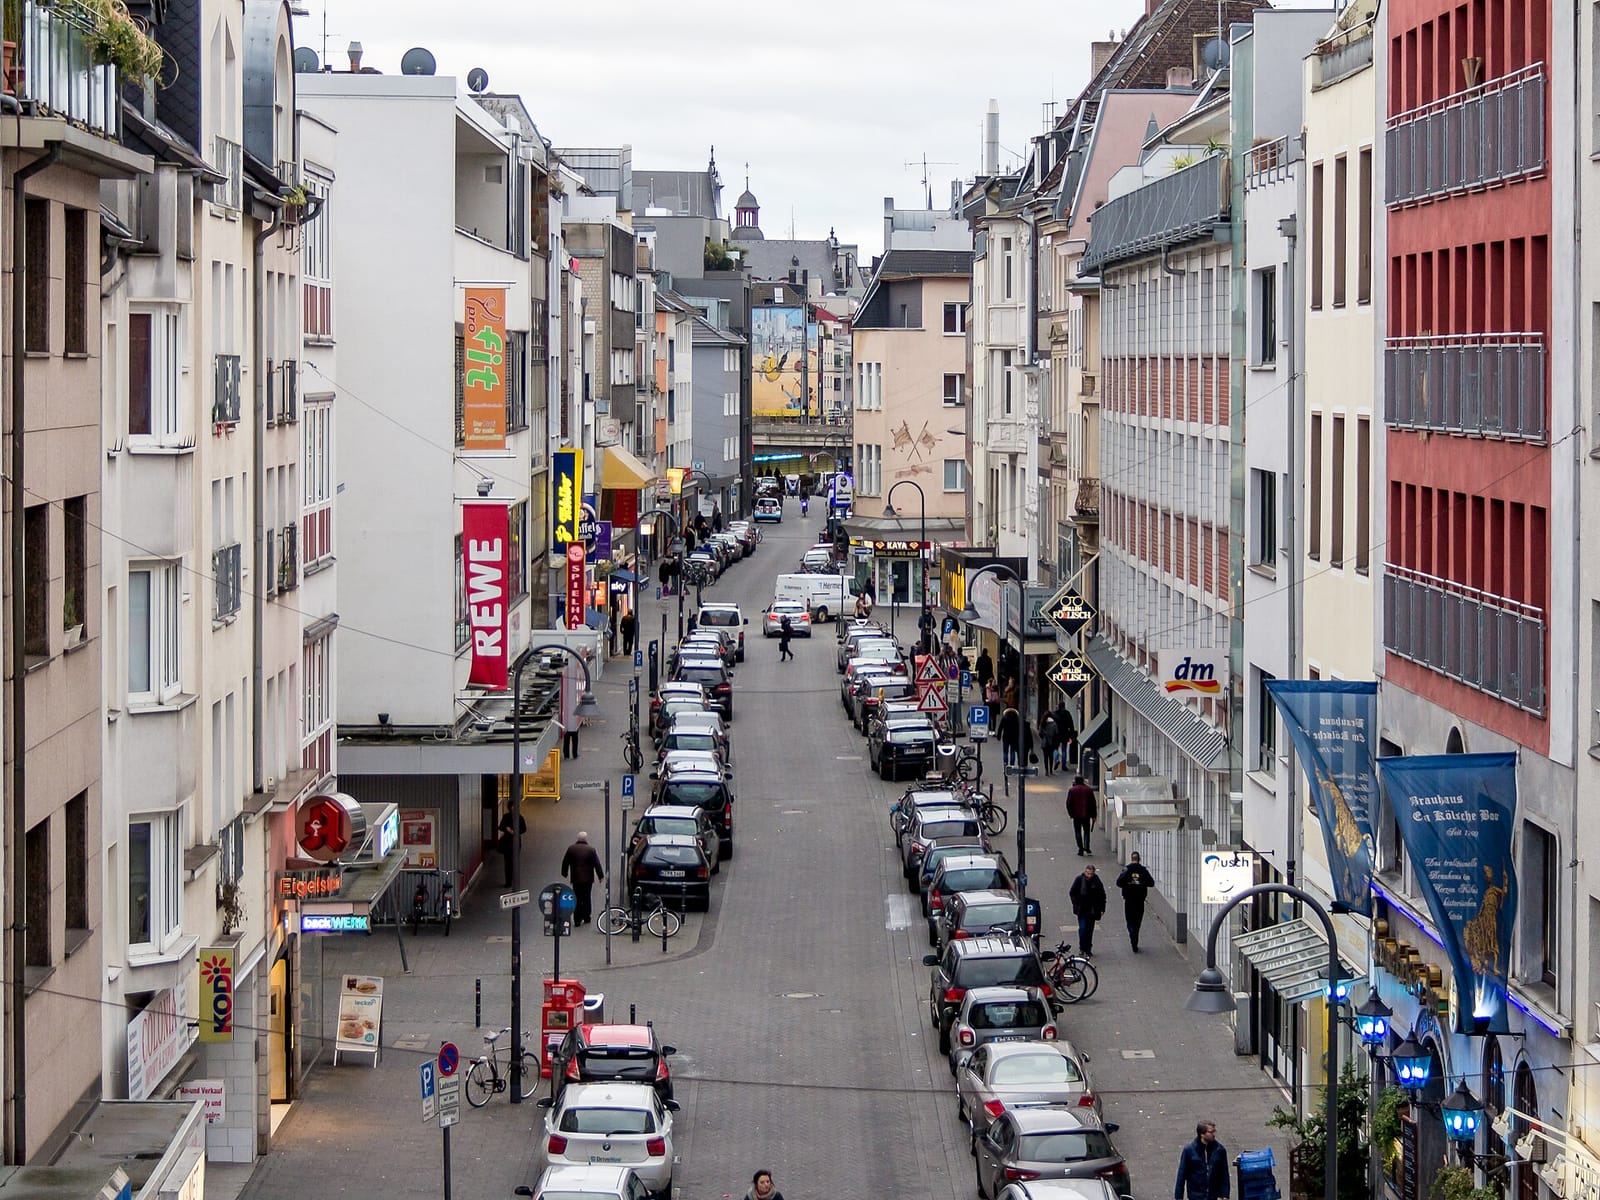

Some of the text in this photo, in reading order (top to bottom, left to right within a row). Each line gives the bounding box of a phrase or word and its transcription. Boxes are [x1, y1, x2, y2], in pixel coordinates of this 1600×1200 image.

[467, 306, 475, 333] pro
[466, 325, 503, 391] fit
[886, 541, 908, 550] KAYA
[611, 582, 627, 591] sky
[469, 538, 502, 657] REWE
[1174, 656, 1214, 681] dm
[1409, 795, 1464, 806] Brauhaus
[1433, 810, 1477, 823] Kölsche
[303, 916, 368, 930] backWERK
[201, 1086, 222, 1094] Verkauf
